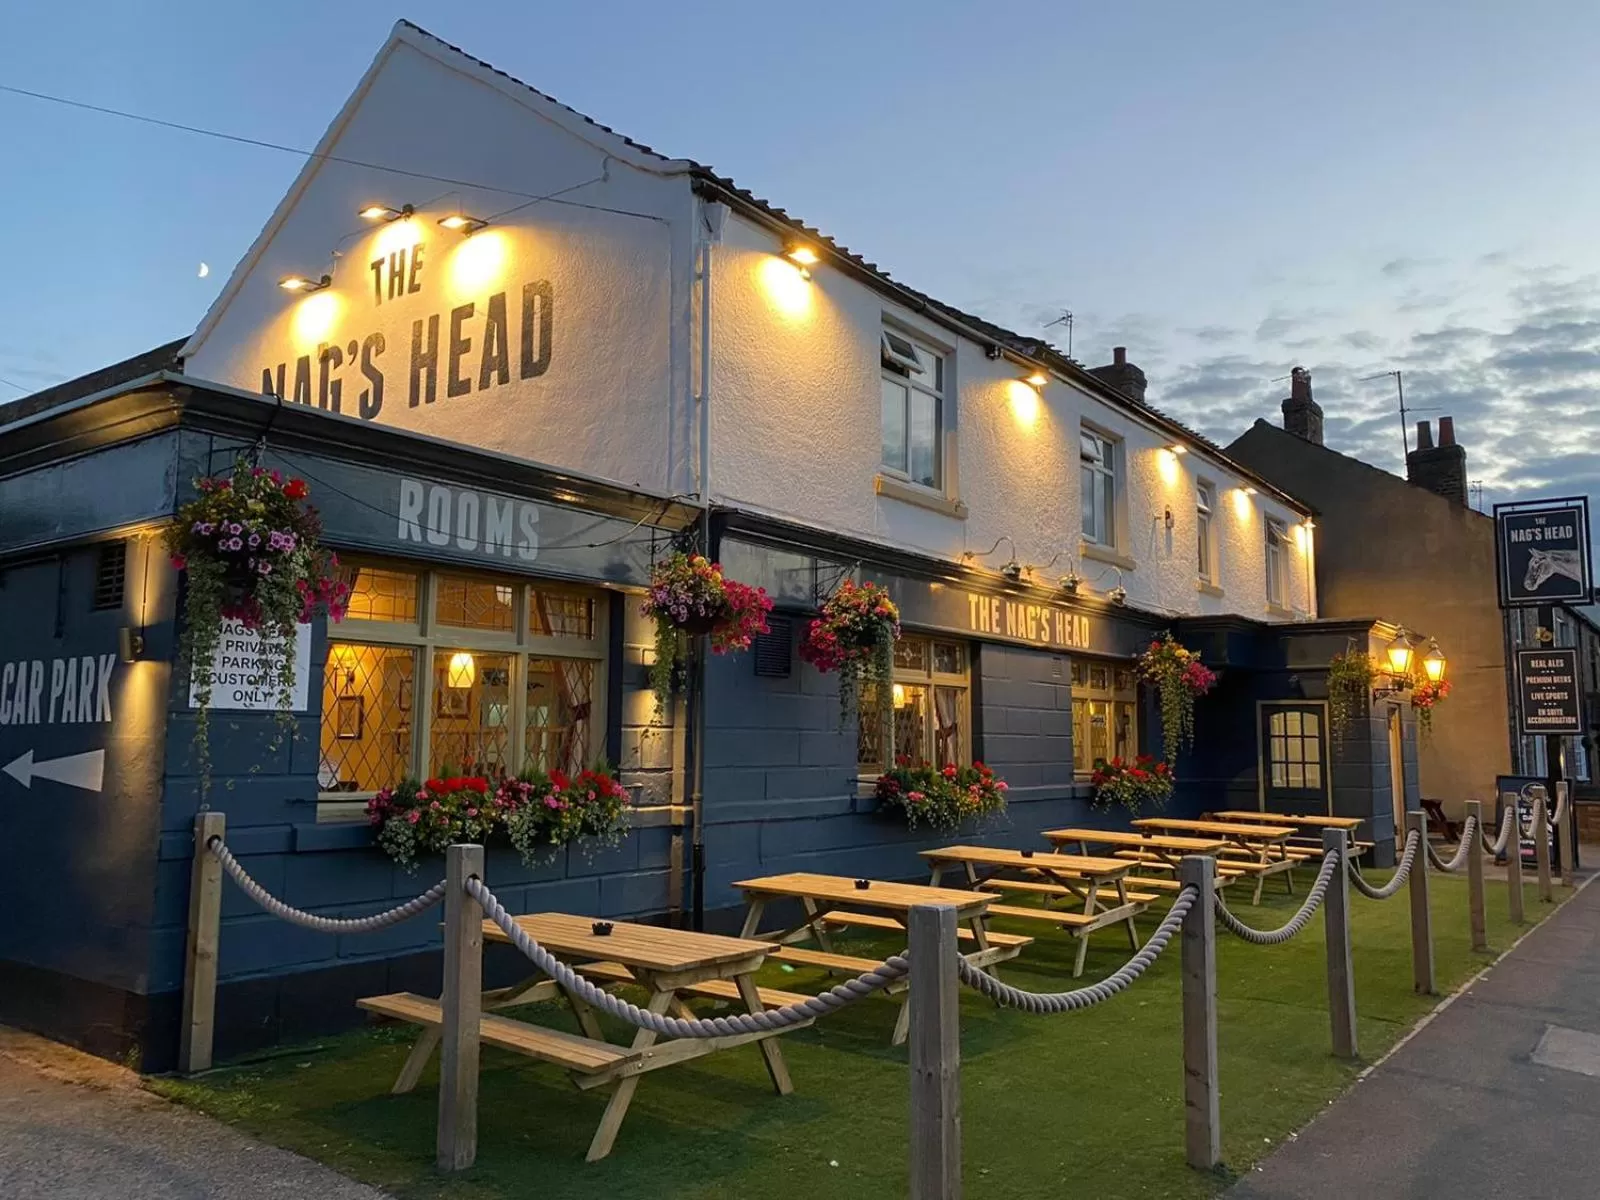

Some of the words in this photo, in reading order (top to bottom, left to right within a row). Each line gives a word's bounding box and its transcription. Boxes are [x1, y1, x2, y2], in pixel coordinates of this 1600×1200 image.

[371, 243, 425, 306] THE
[409, 279, 554, 408] HEAD
[398, 479, 540, 561] ROOMS
[1511, 528, 1542, 543] NAG'S
[1544, 525, 1573, 540] HEAD
[968, 593, 1001, 634] THE
[1006, 602, 1050, 642] NAG'S
[1055, 612, 1090, 649] HEAD
[222, 656, 285, 671] PARKNG
[1531, 659, 1546, 668] REAL
[1548, 659, 1564, 668] ALES
[1526, 676, 1552, 684] PREMIUM
[1553, 675, 1572, 683] BEERS
[0, 660, 44, 725] CAR
[48, 653, 117, 724] PARK
[233, 689, 270, 703] ONLY
[1531, 692, 1544, 700] LIVE
[1545, 692, 1568, 700] SPORTS
[1547, 708, 1563, 716] SUITE
[1528, 716, 1576, 724] ACCOMMODATION
